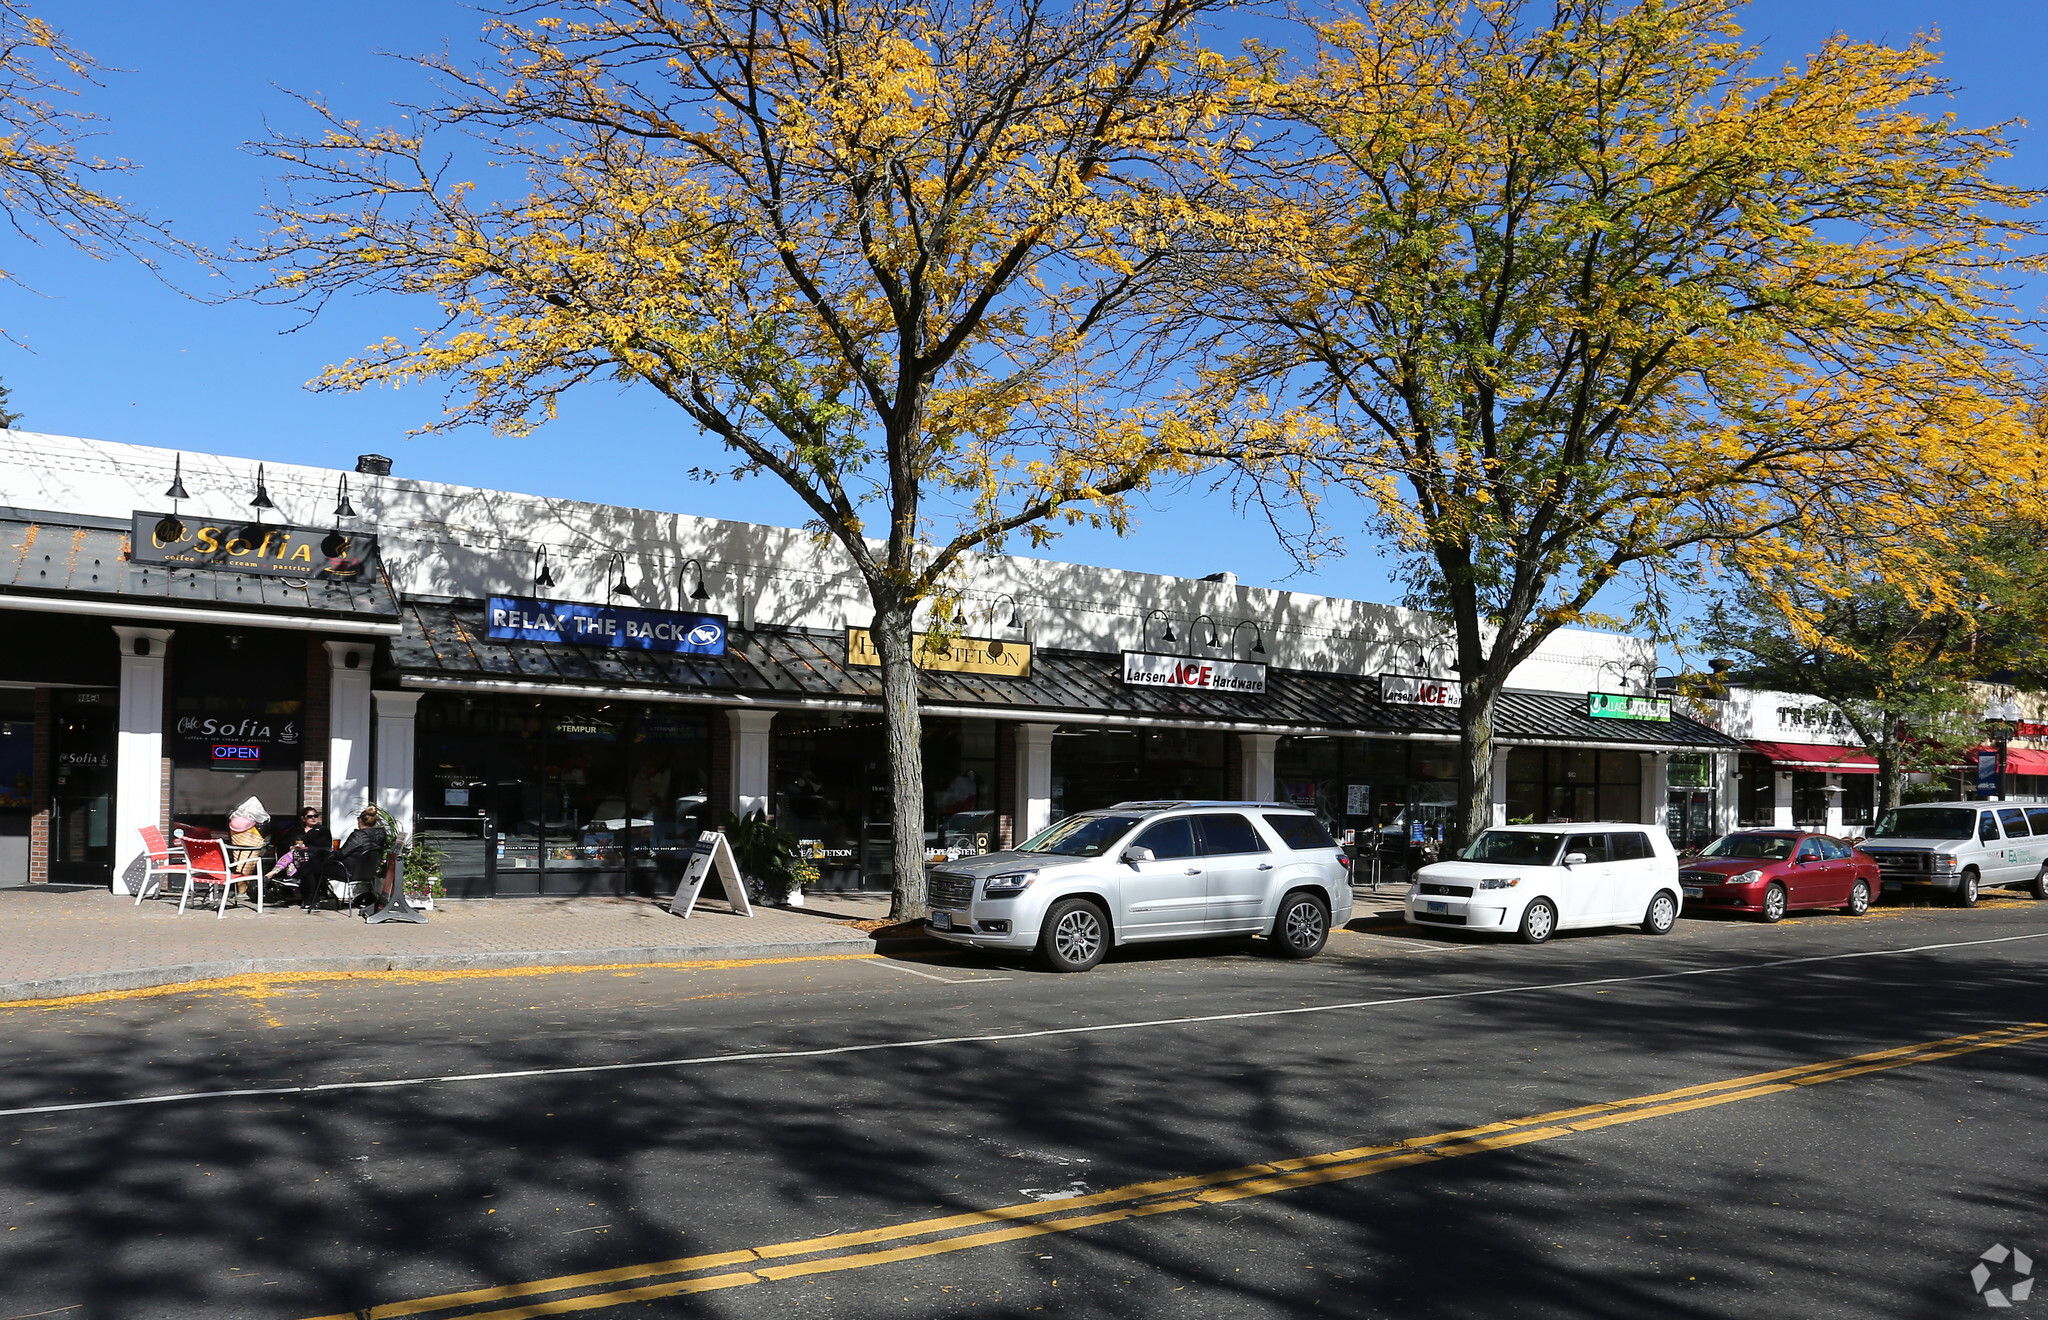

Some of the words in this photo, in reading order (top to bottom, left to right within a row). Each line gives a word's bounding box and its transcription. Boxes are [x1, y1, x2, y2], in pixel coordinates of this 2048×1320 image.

[164, 554, 195, 563] coffee
[210, 557, 225, 565] ice
[229, 560, 258, 568] cream
[272, 563, 311, 573] pastries
[493, 608, 565, 632] RELAX
[573, 616, 616, 636] THE
[626, 621, 685, 642] BACK
[939, 646, 1020, 667] STETSON
[1127, 668, 1166, 683] Larsen
[1167, 660, 1213, 686] ACE
[1213, 676, 1263, 690] Hardware
[1383, 688, 1413, 702] Larsen
[1414, 683, 1448, 704] ACE
[561, 725, 597, 734] TEMPUR
[214, 746, 259, 758] OPEN
[816, 848, 852, 857] STETSON
[956, 848, 977, 856] STETS
